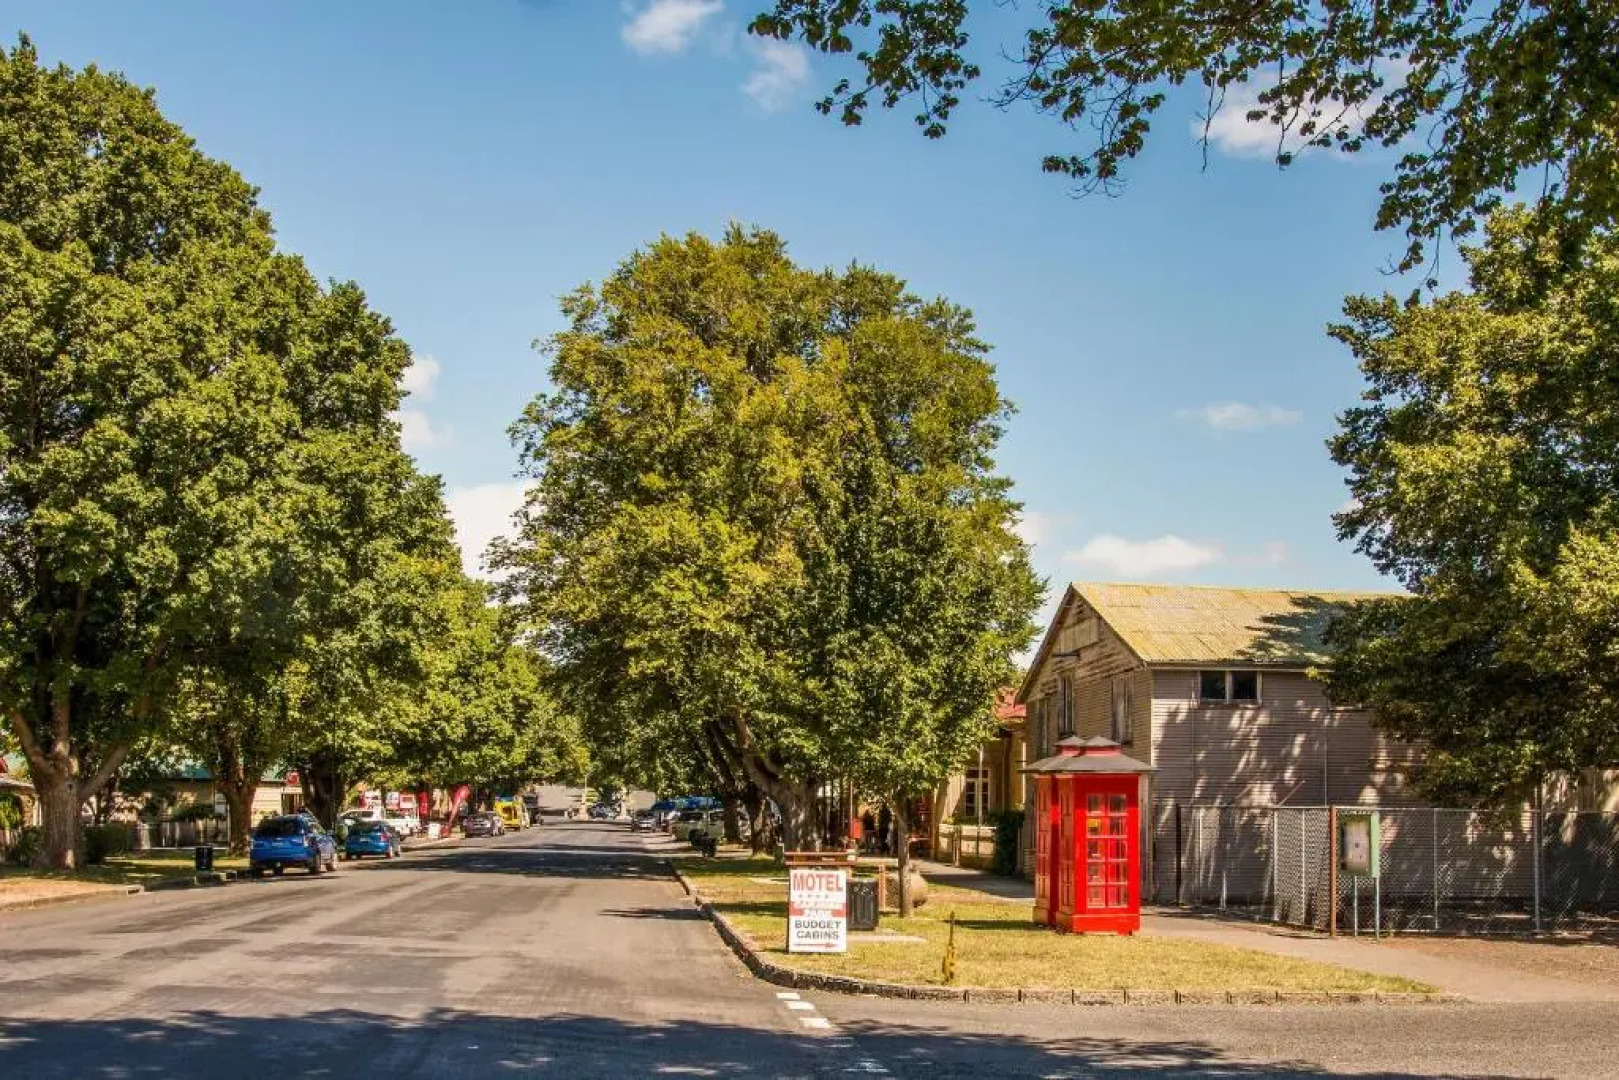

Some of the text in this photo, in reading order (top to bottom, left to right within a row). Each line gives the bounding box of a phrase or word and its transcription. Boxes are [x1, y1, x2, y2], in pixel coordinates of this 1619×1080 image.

[793, 873, 843, 891] MOTEL
[795, 920, 841, 929] BUDGET
[796, 931, 839, 940] CABINS
